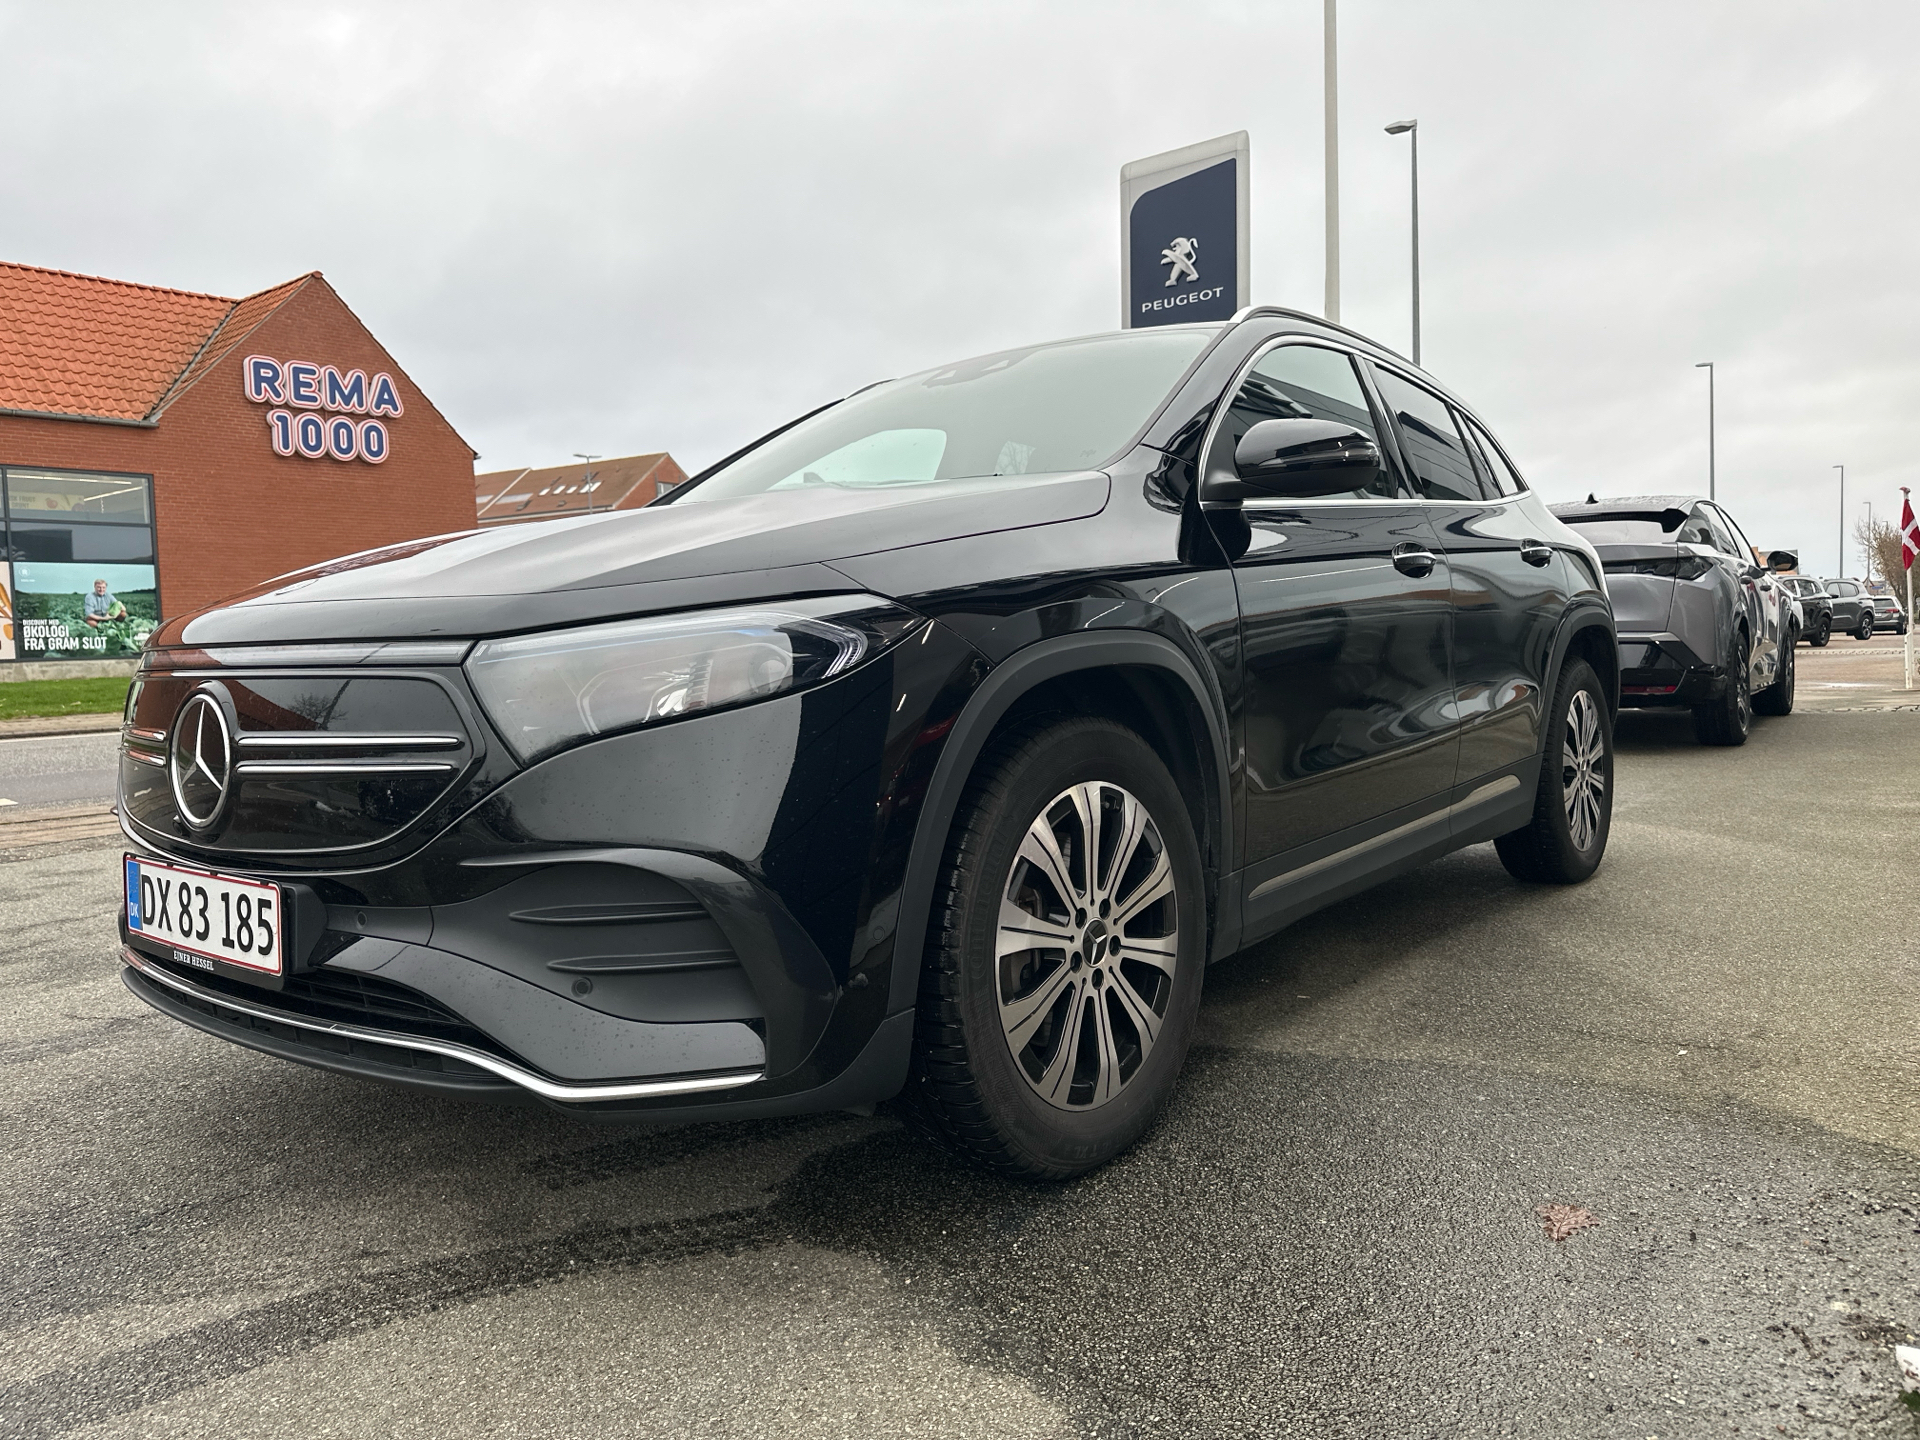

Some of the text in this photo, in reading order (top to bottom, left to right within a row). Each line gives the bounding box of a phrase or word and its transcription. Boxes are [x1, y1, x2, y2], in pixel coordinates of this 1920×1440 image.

[1141, 286, 1224, 313] PEUGEOT
[246, 356, 403, 417] REMA
[269, 411, 389, 463] 1000
[23, 625, 70, 638] ØKOLOGI
[24, 636, 108, 651] FRA GRAM SLOT
[130, 902, 139, 919] DK
[141, 874, 274, 956] DX 83 185
[173, 950, 215, 971] EJNER HESSEL
